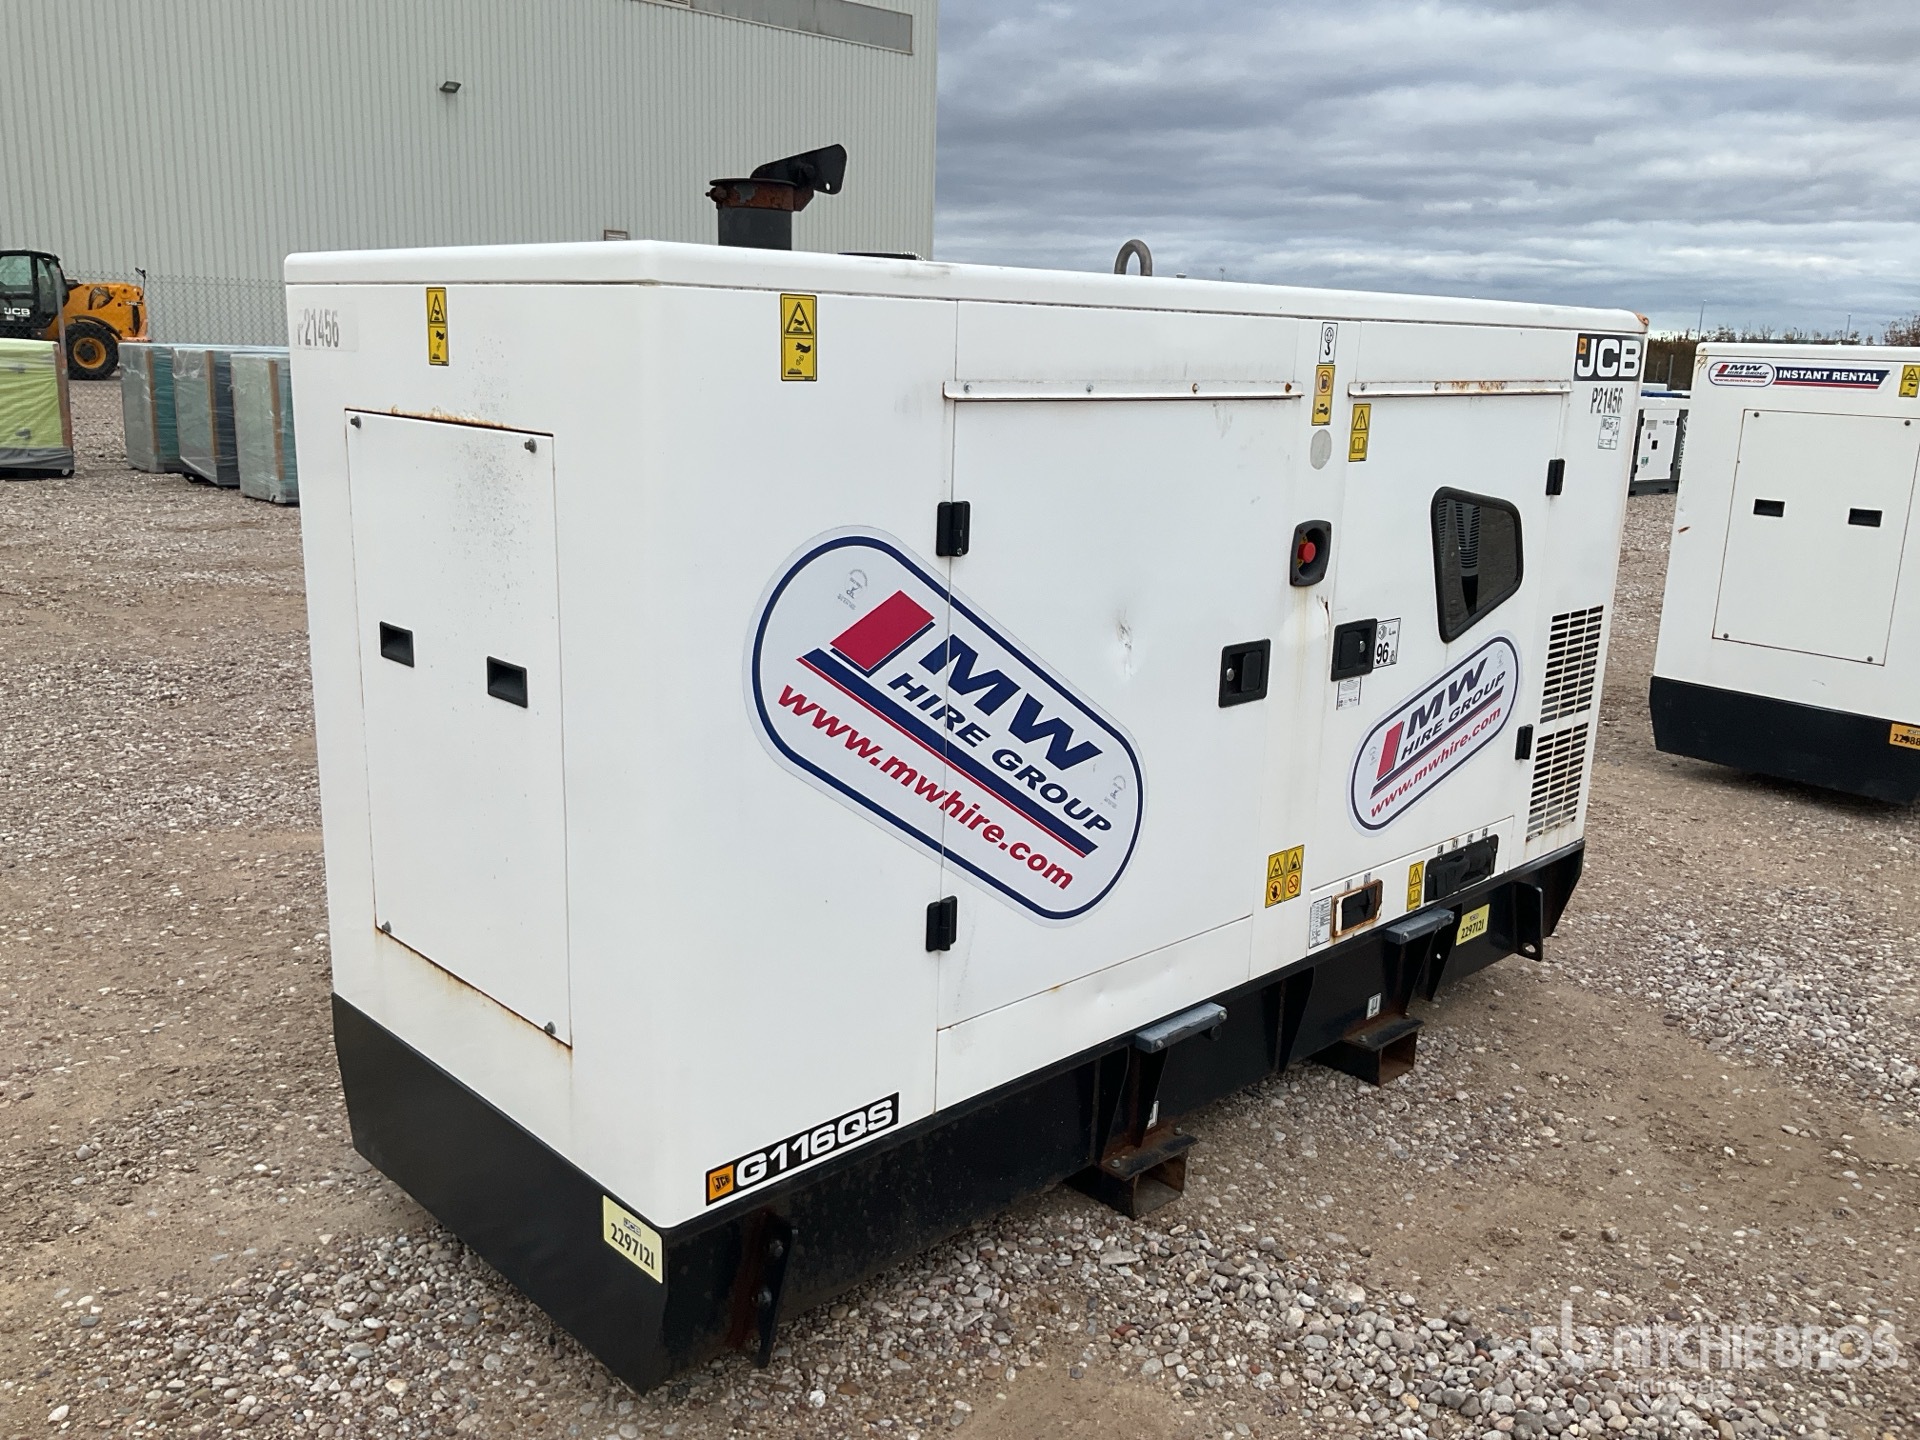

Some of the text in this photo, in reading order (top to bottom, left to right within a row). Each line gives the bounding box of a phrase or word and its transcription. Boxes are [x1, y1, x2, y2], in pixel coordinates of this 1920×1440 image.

[4, 307, 31, 316] JCB
[1576, 338, 1642, 378] JCB
[1778, 369, 1880, 382] INSTANT RENTAL
[1590, 387, 1624, 414] P21456
[1376, 641, 1390, 664] 96
[918, 633, 1103, 772] MW
[1400, 671, 1506, 761] HIRE GROUP
[1406, 656, 1489, 740] MW
[887, 672, 1112, 833] HIRE GROUP
[1370, 707, 1501, 818] www.mwhire.com
[777, 684, 1074, 890] www.mwhire.com
[1461, 918, 1485, 940] 2297121
[736, 1099, 893, 1187] G116QS
[610, 1222, 655, 1271] 2297121
